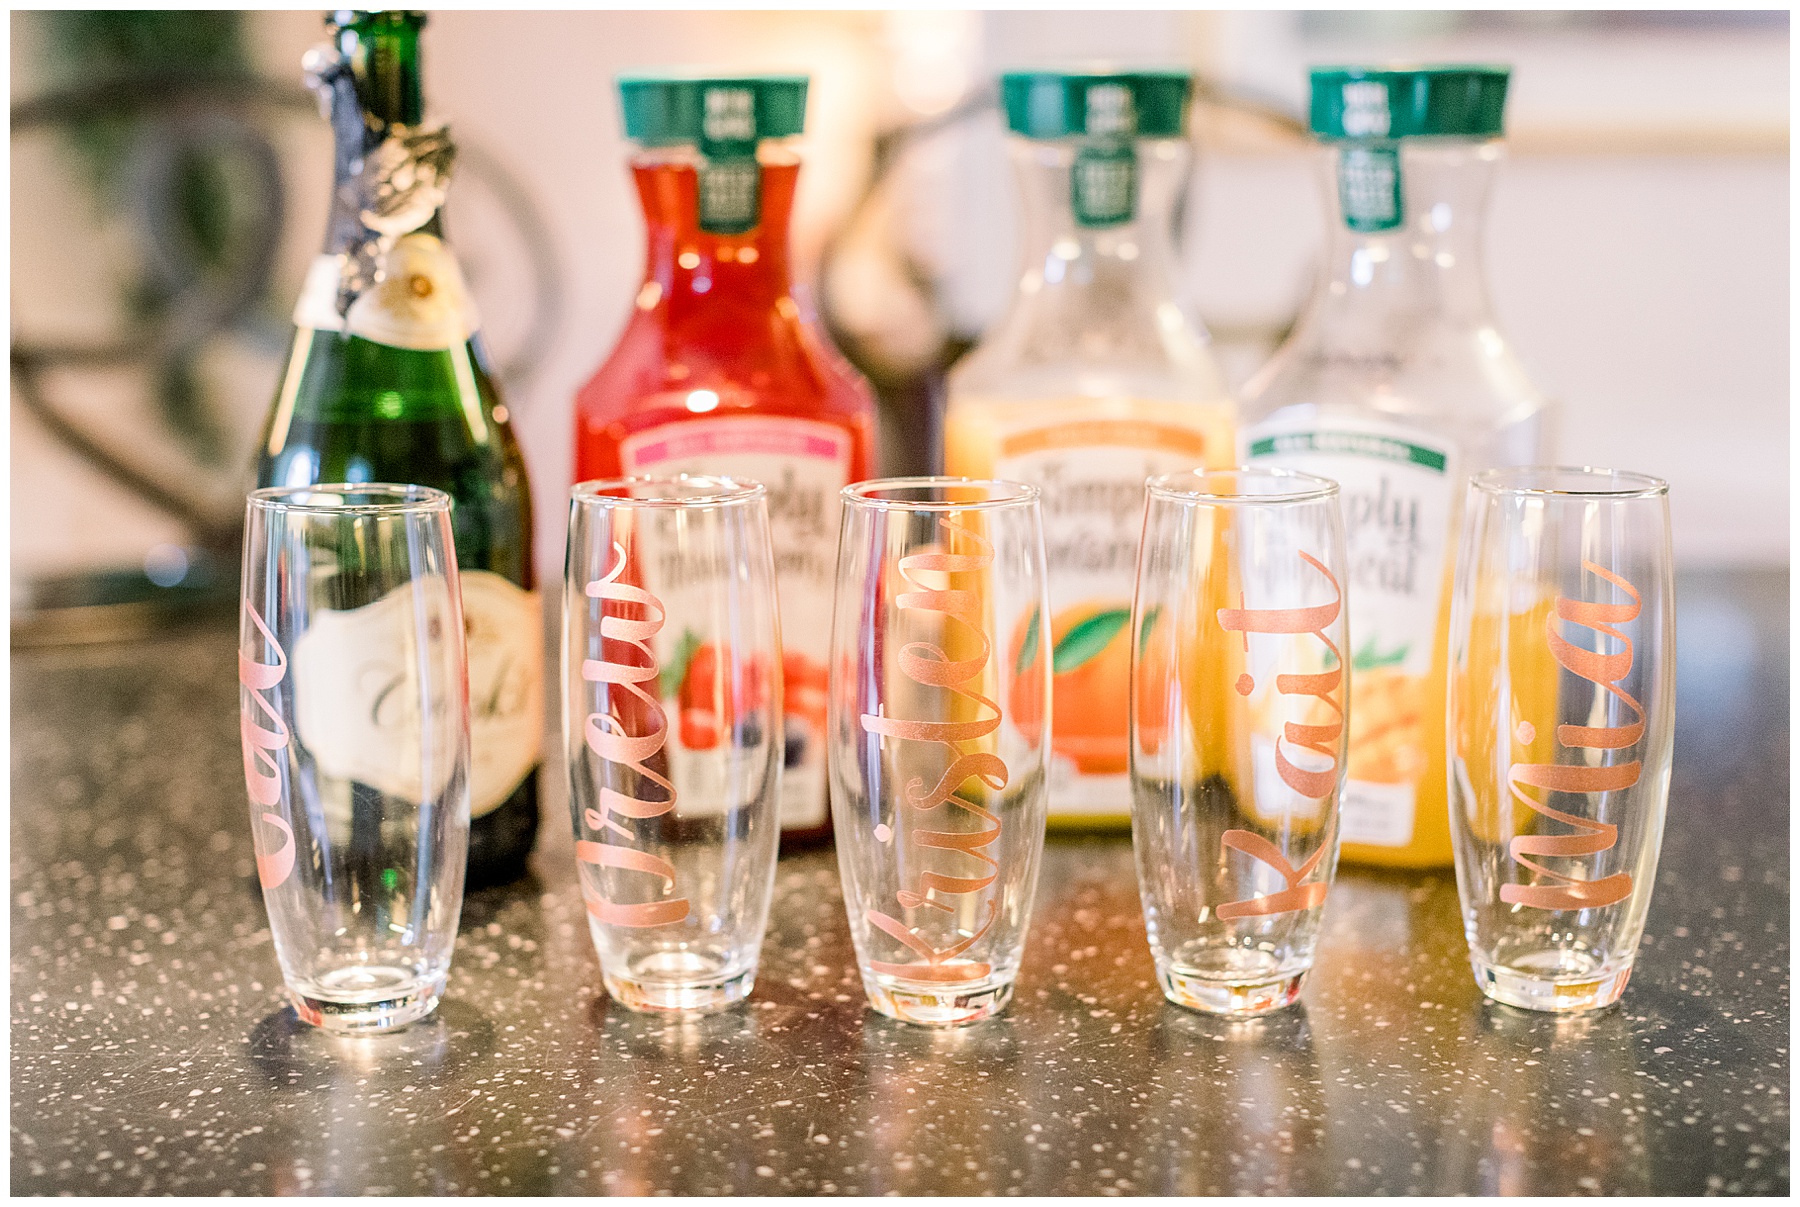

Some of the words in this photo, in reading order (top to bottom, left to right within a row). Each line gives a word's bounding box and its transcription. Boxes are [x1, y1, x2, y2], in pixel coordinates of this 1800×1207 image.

[859, 517, 1009, 983] Kristen
[1215, 549, 1343, 921] Kait
[1499, 559, 1646, 911] Mia
